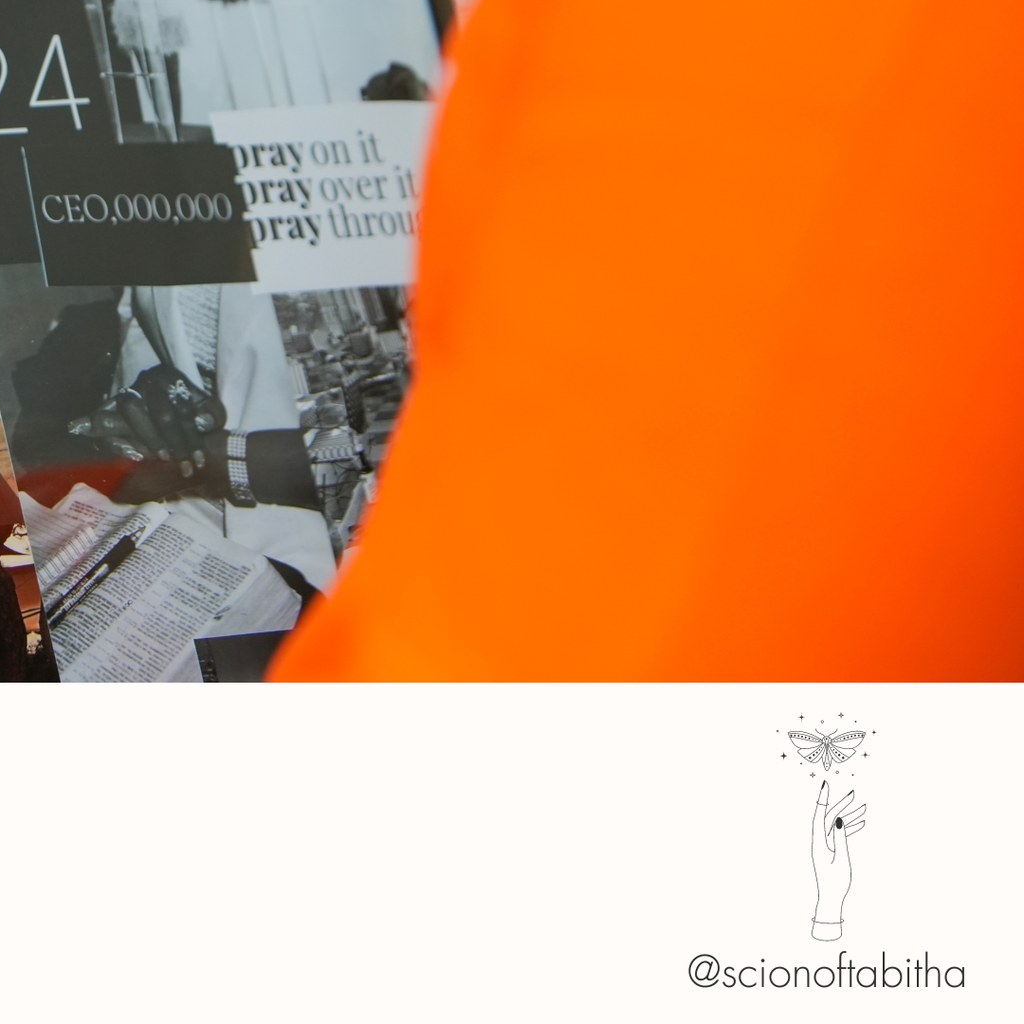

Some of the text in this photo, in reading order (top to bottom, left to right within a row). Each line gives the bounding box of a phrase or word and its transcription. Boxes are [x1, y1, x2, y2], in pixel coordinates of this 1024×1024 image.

[310, 139, 352, 166] on
[357, 129, 385, 165] it
[320, 174, 388, 202] over
[392, 165, 420, 199] it
[41, 192, 233, 225] CEO,000,000
[328, 203, 423, 240] throu
